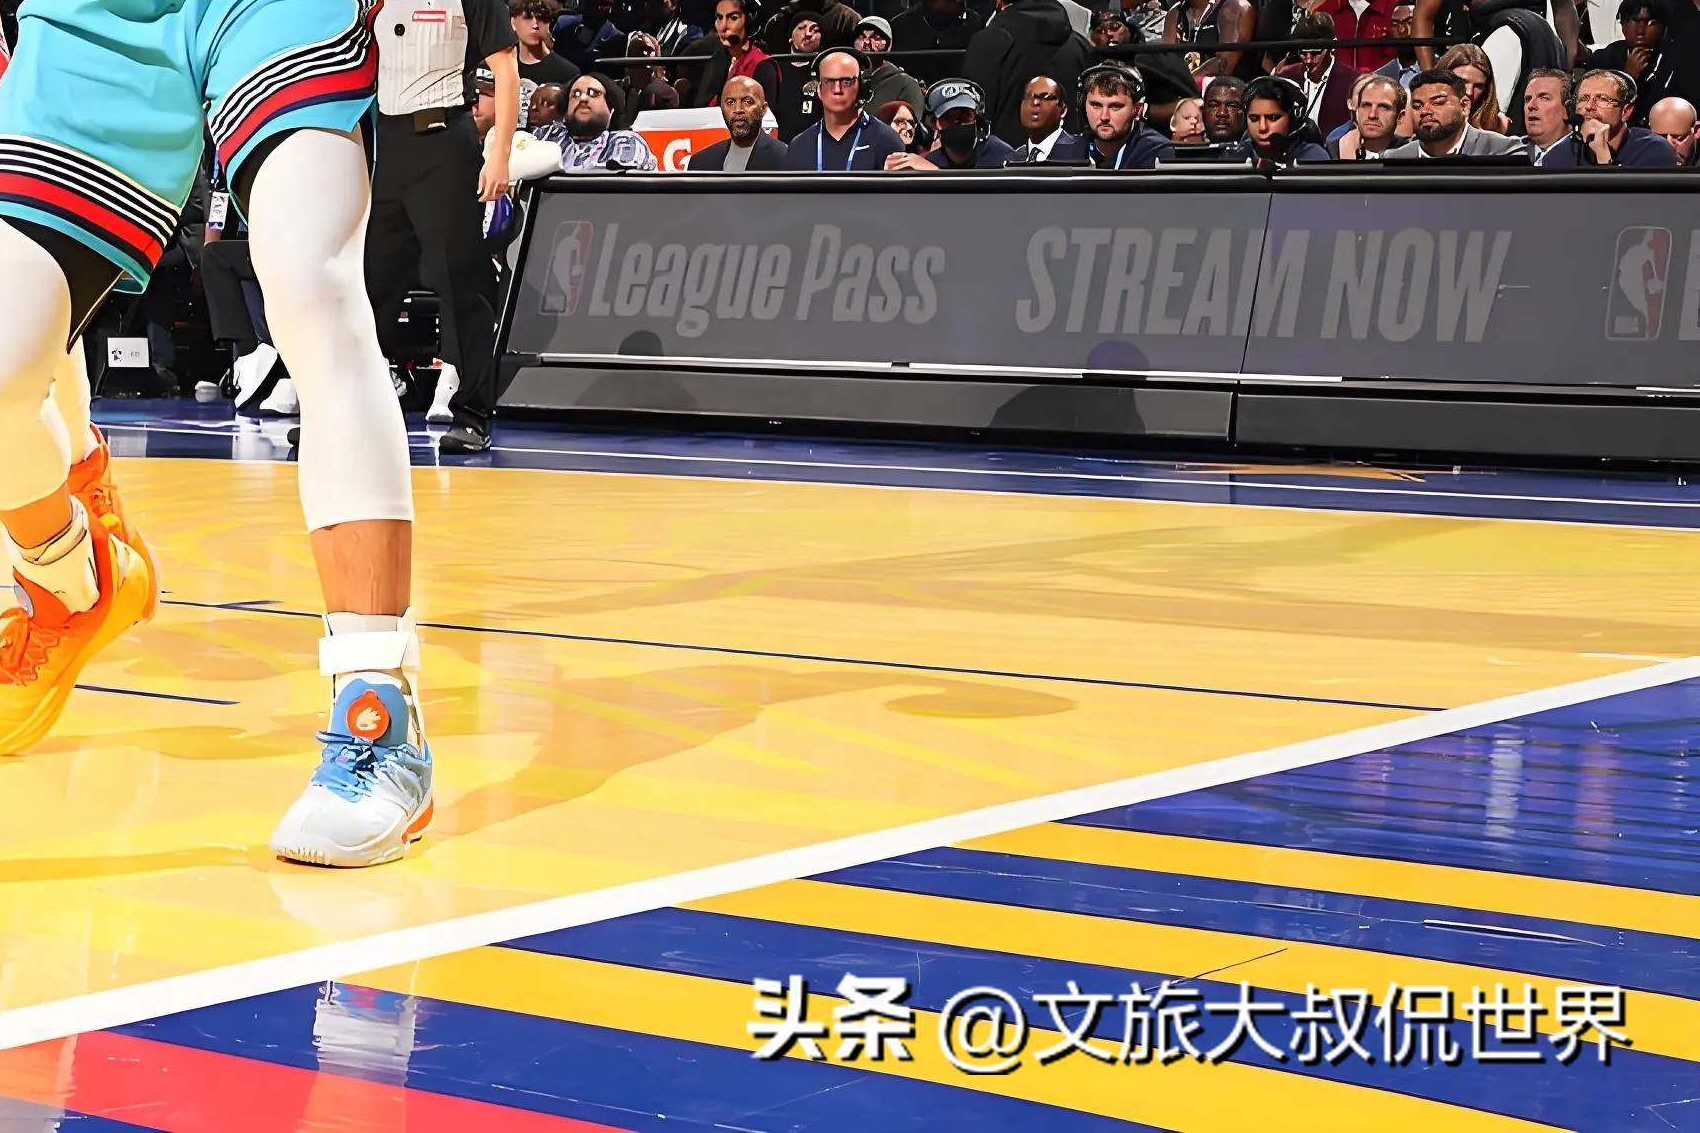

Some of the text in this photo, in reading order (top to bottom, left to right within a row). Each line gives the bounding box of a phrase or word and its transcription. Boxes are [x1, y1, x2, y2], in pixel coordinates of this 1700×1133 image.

[663, 138, 692, 171] G
[588, 222, 946, 337] League Pass
[1015, 226, 1513, 342] STREAM NOW
